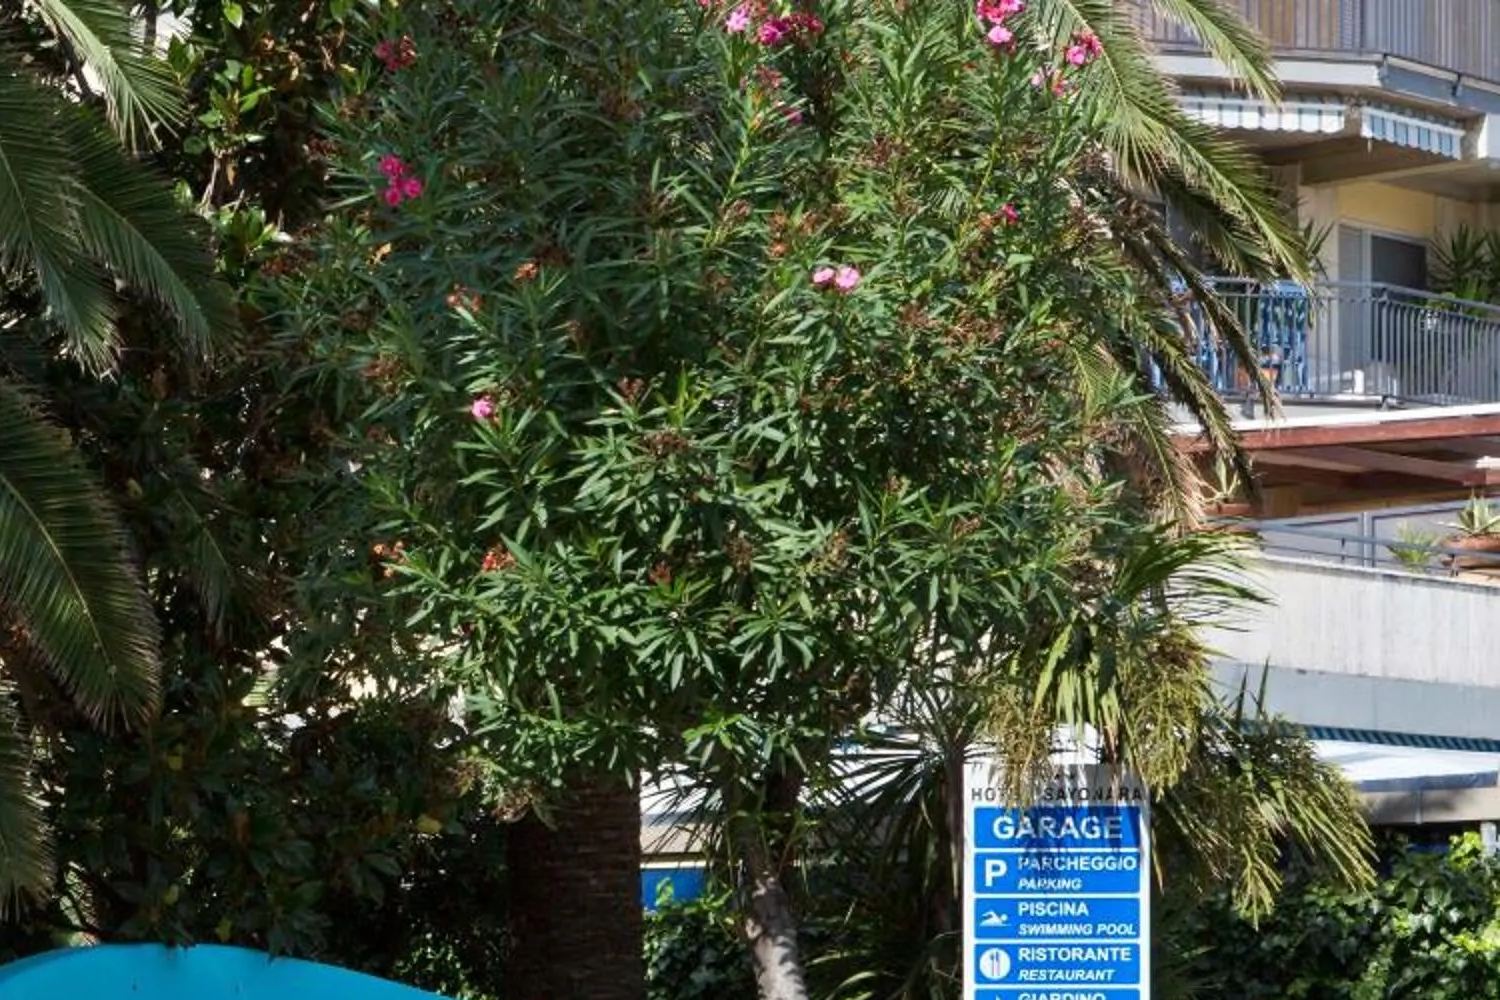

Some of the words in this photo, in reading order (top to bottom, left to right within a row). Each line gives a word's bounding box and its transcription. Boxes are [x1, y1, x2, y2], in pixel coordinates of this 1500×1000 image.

[1043, 787, 1142, 801] SAYONARA
[992, 816, 1123, 840] GARAGE
[1017, 856, 1137, 871] PARCHEGGIO
[985, 859, 1007, 887] P
[1018, 878, 1083, 890] PARKING
[1018, 902, 1089, 916] PISCINA
[1018, 924, 1093, 936] SWIMMING
[1097, 924, 1137, 935] POOL
[1018, 948, 1132, 961] RISTORANTE
[1018, 969, 1115, 981] RESTAURANT
